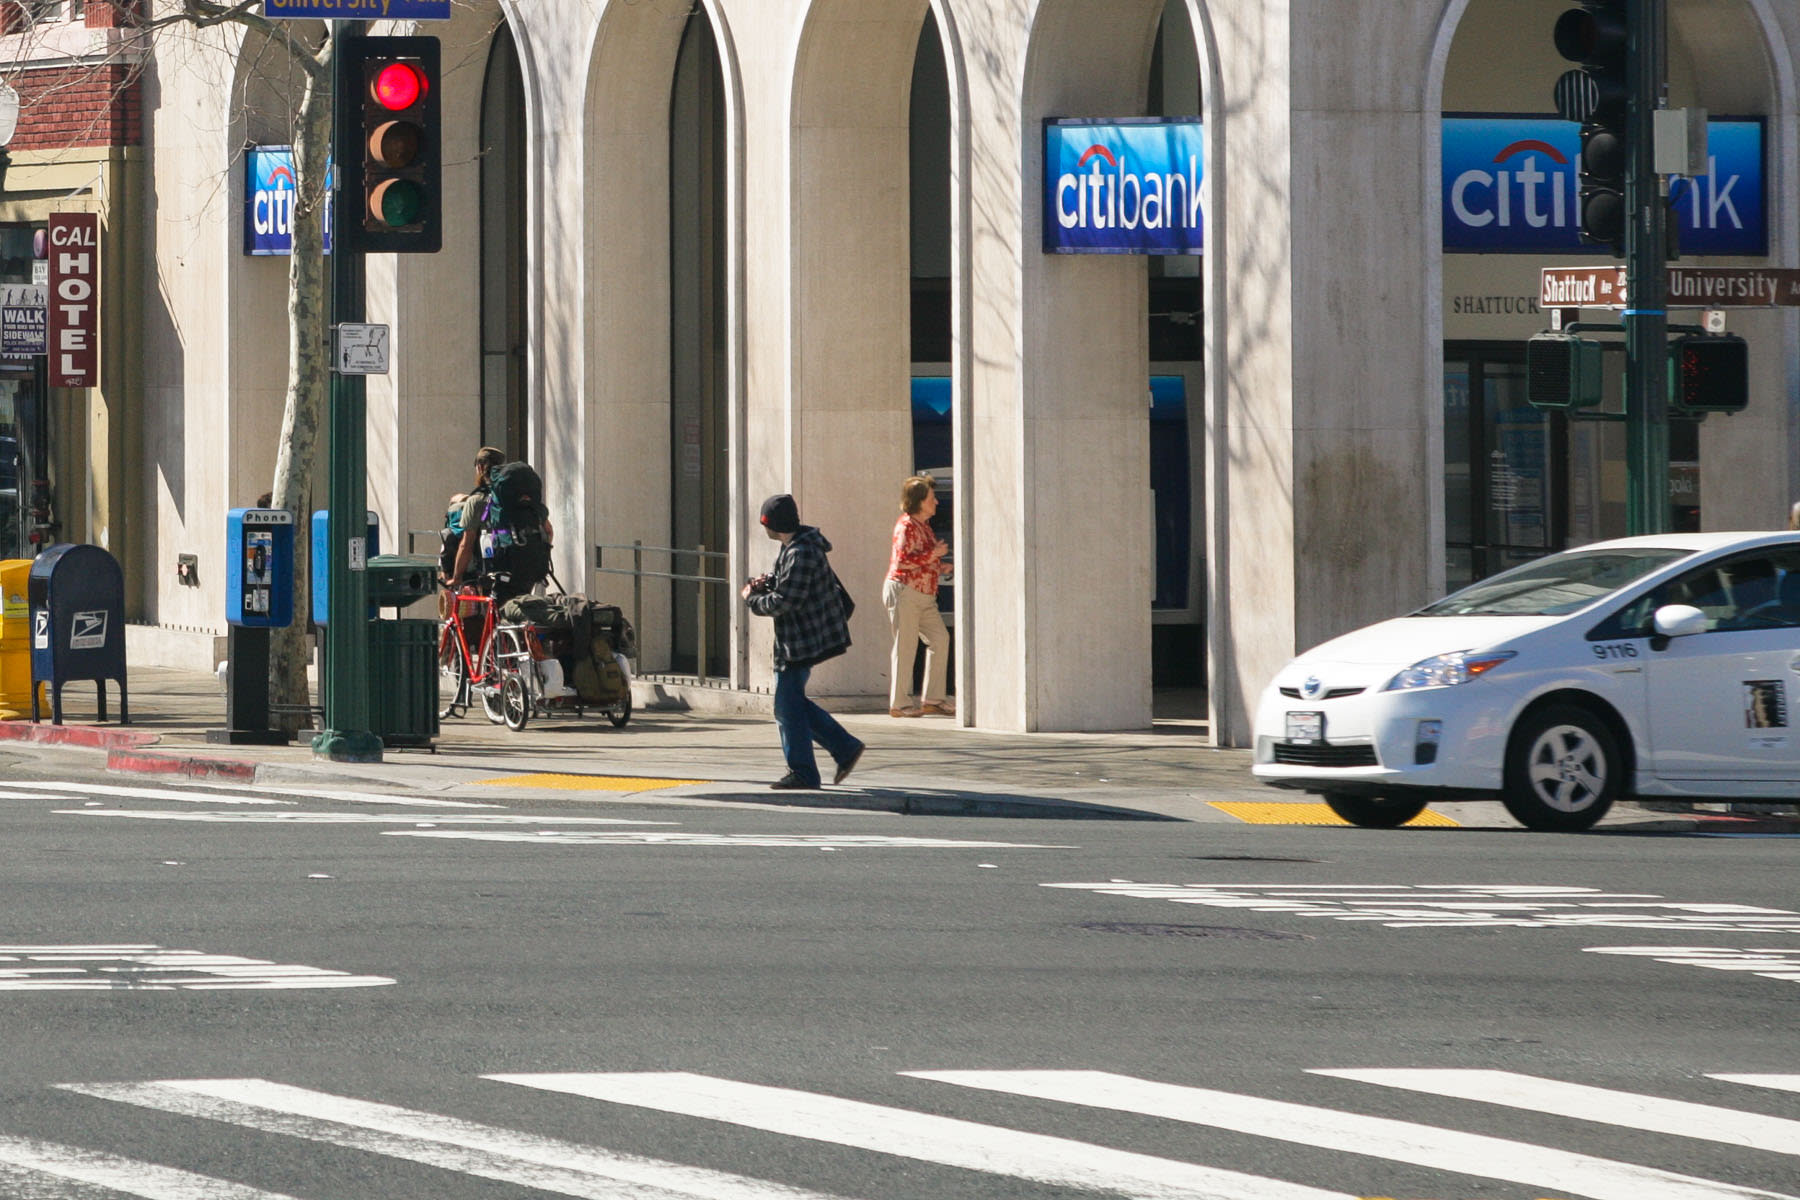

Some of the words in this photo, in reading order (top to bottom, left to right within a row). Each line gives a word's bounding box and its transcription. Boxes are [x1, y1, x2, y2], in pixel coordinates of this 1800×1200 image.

[1057, 155, 1205, 230] citibank
[1452, 155, 1743, 230] citink
[52, 226, 96, 246] CAL
[1670, 271, 1778, 304] University
[58, 253, 91, 375] HOTEL
[1454, 296, 1540, 313] SHATTUCK
[4, 310, 44, 323] WALK
[247, 513, 286, 522] Phone
[1593, 642, 1638, 659] 9116
